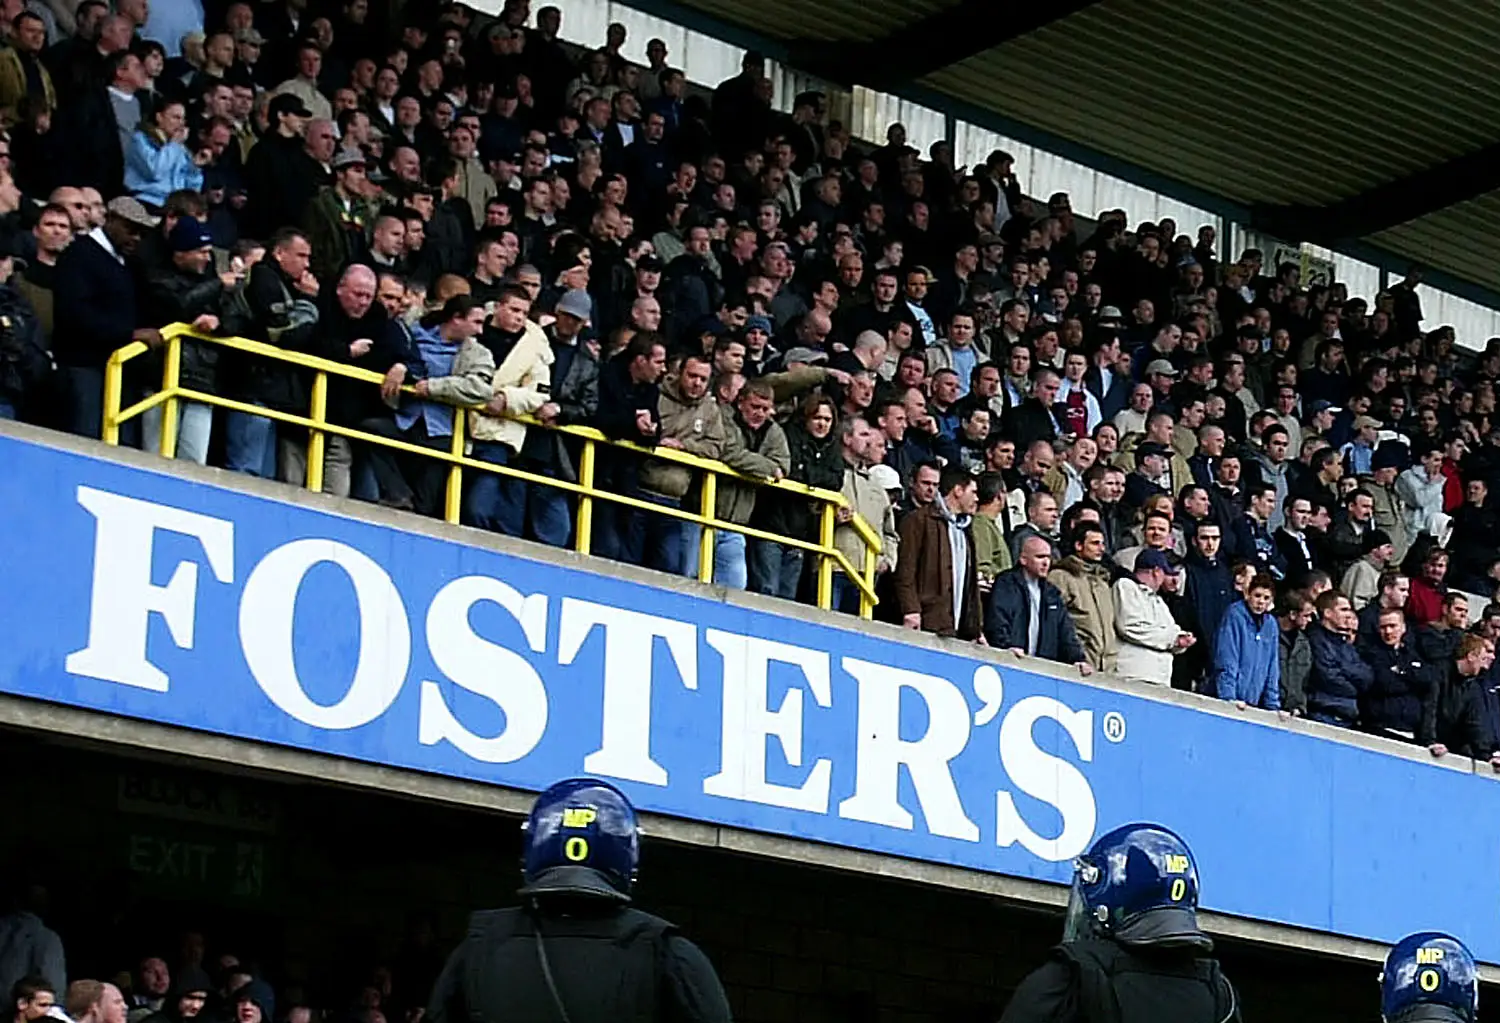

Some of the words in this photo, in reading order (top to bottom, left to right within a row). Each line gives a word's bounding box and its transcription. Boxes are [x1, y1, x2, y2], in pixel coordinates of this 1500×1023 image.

[67, 486, 1097, 861] FOSTER'S
[563, 808, 597, 828] MP
[130, 833, 216, 882] EXIT
[1165, 854, 1190, 873] MP
[1416, 947, 1445, 964] MP
